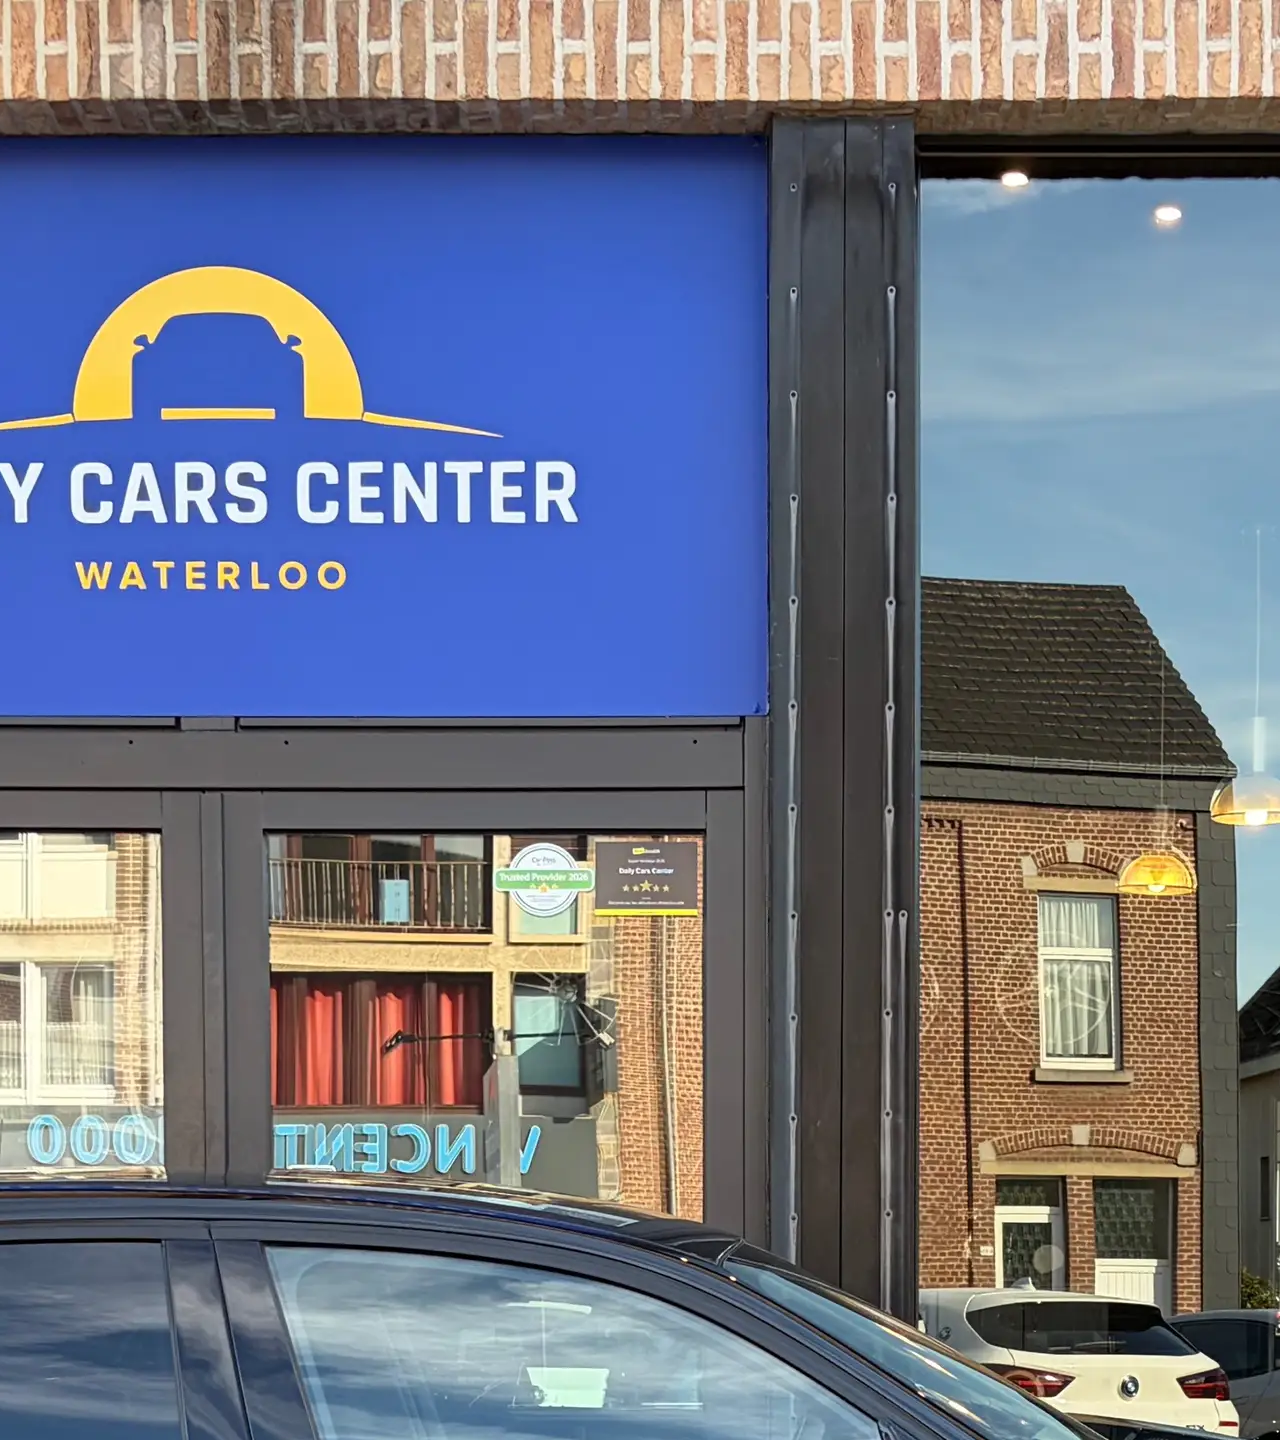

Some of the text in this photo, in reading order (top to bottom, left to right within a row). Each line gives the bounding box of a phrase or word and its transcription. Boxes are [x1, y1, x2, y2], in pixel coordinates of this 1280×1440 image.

[69, 461, 268, 524] CARS
[295, 460, 579, 523] CENTER
[75, 560, 349, 591] WATERLOO
[499, 872, 589, 881] Trusted Provider 2026
[619, 867, 674, 876] Daily Cars Center
